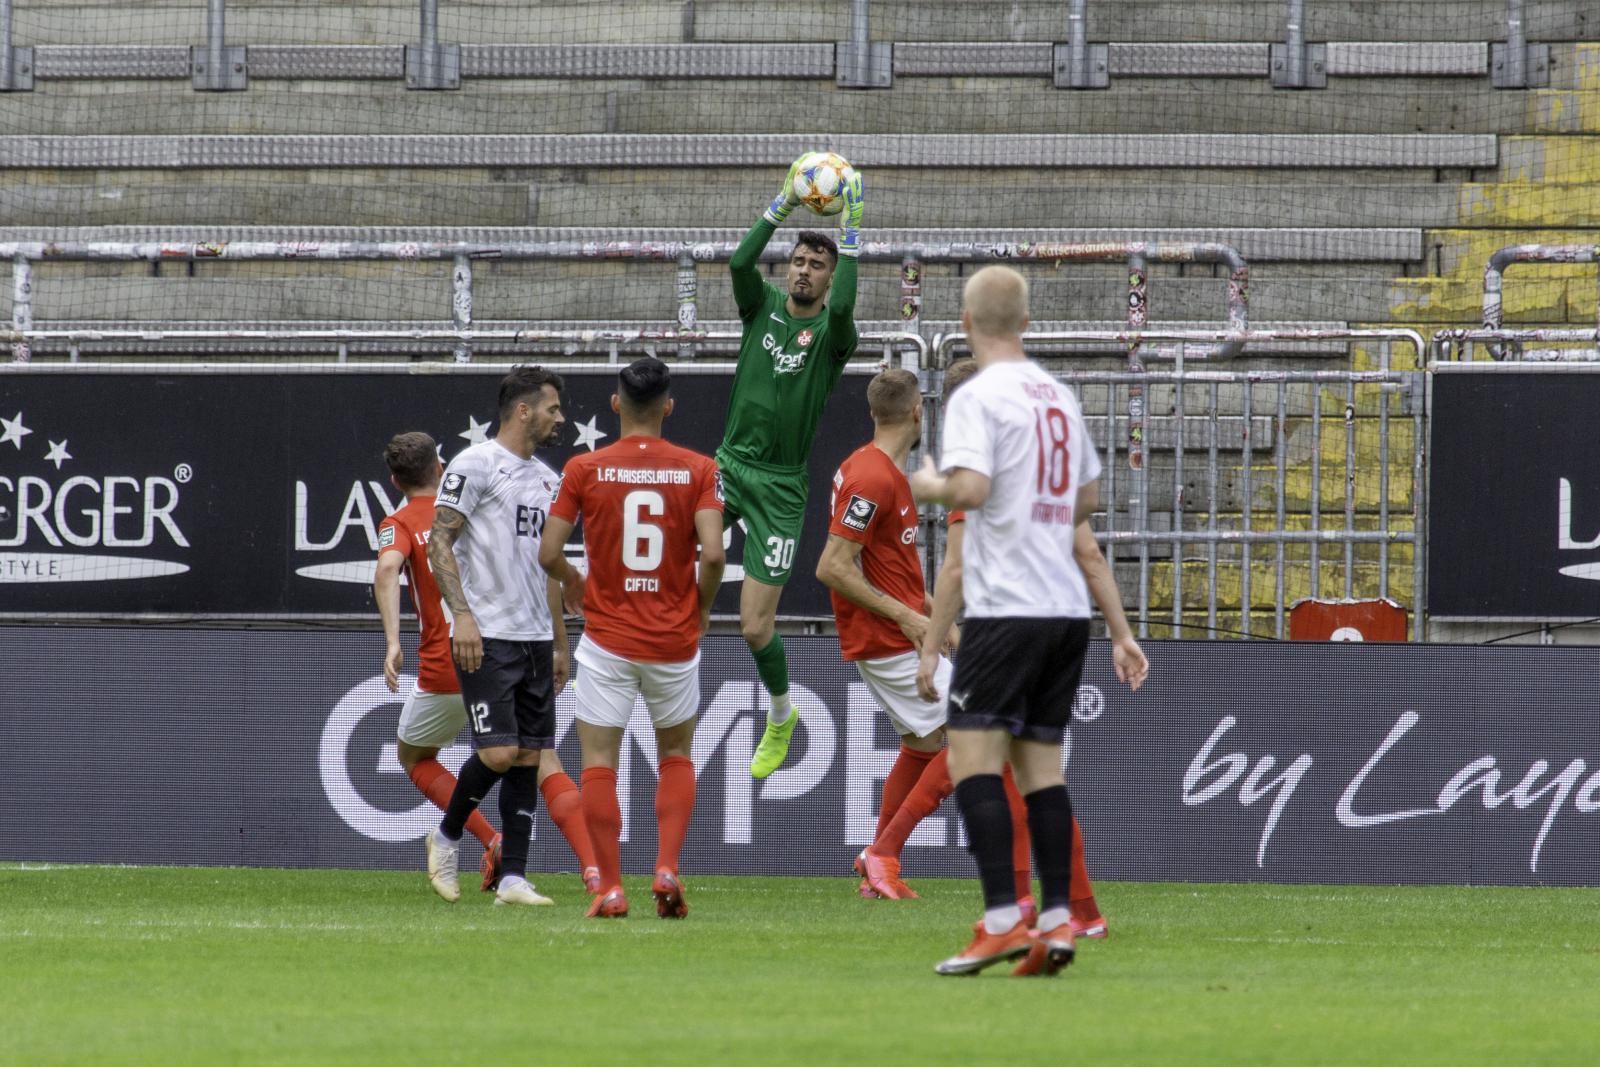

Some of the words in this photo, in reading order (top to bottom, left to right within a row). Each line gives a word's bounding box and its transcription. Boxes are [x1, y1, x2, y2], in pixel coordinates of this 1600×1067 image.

[1034, 405, 1070, 497] 18
[617, 469, 690, 485] KAISERSLAUTERN
[622, 490, 664, 571] 6
[843, 515, 866, 530] bwin
[764, 536, 795, 570] 30
[624, 577, 659, 593] CIFTCI
[471, 702, 492, 734] 12
[1182, 715, 1313, 868] by
